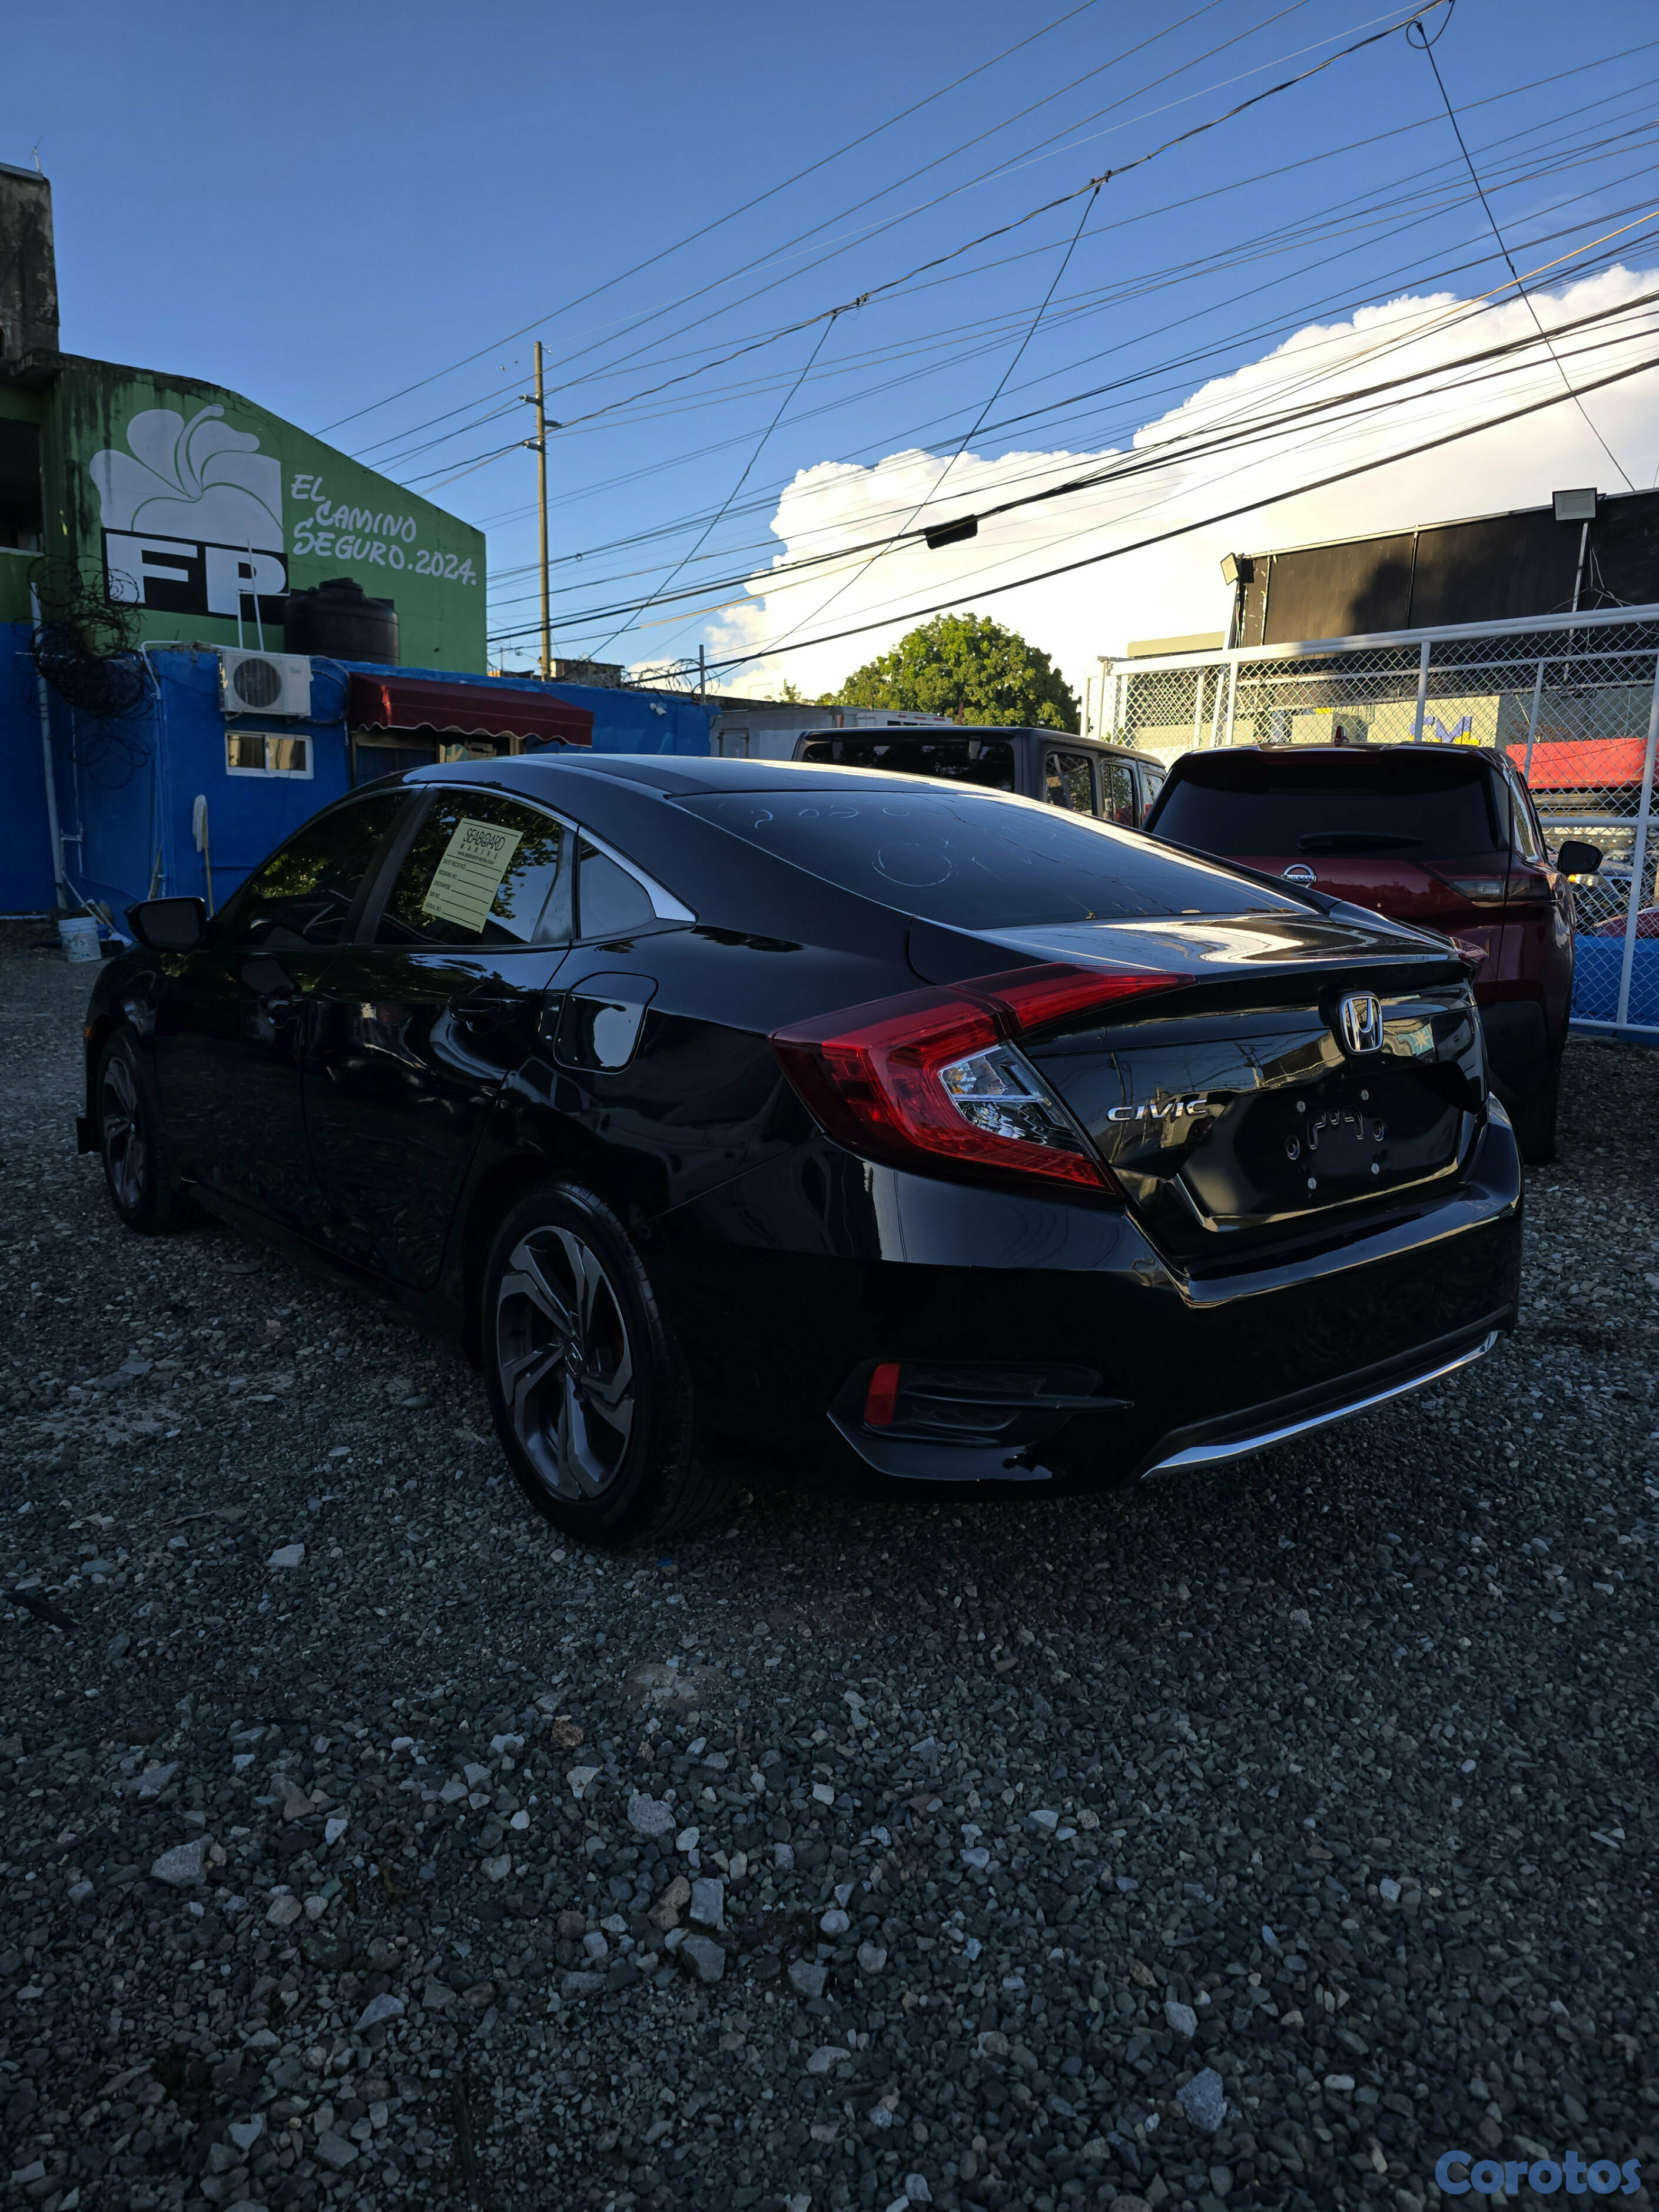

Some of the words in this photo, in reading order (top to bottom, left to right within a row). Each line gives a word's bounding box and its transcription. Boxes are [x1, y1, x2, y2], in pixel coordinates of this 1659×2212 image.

[291, 474, 326, 502] EL
[316, 500, 417, 543] CAMINO
[105, 532, 287, 616] FP
[460, 843, 499, 860] MARINE
[463, 828, 506, 851] SEABOARD
[1107, 1099, 1207, 1122] CIVIC
